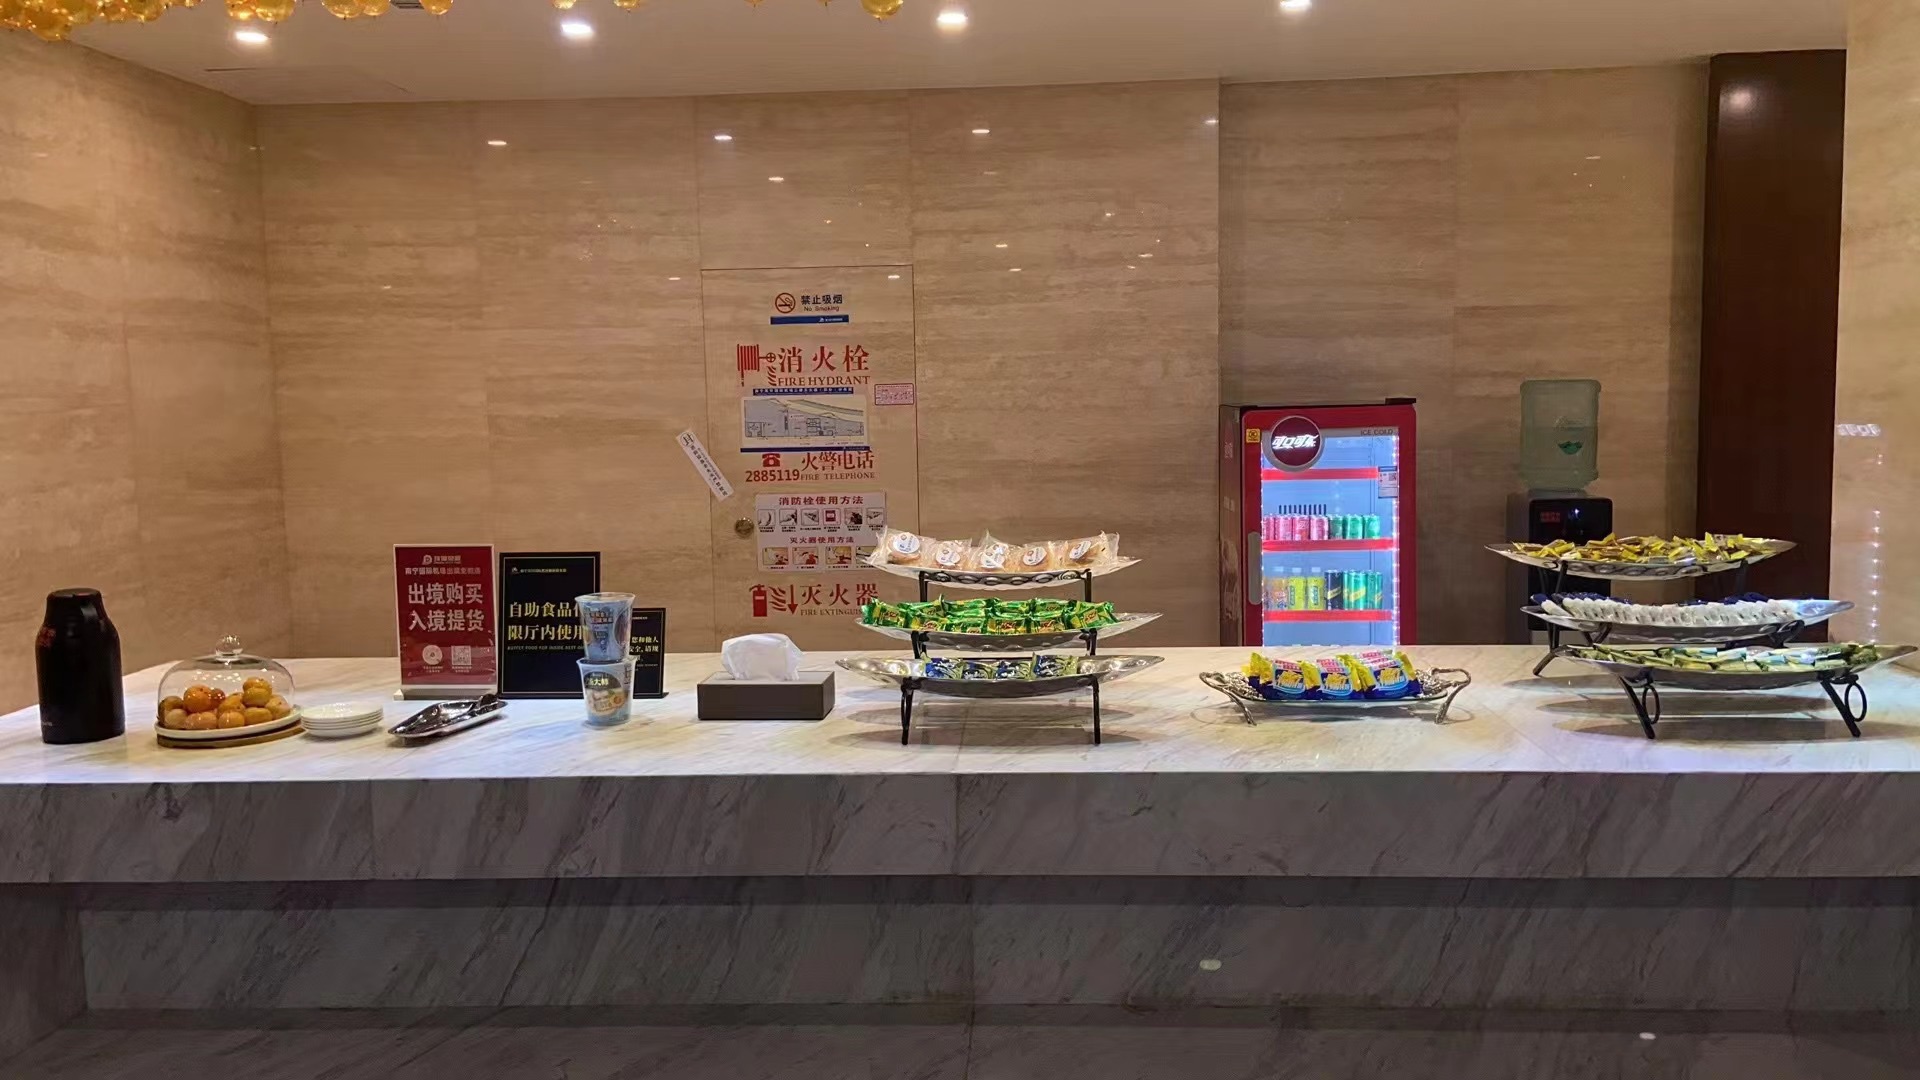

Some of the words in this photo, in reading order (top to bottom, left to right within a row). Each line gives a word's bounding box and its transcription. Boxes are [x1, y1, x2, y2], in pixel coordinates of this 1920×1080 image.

[801, 294, 843, 305] 禁止吸烟
[777, 344, 870, 373] 消火栓
[778, 377, 806, 387] FIRE
[808, 375, 871, 387] HYDRANT
[1271, 433, 1319, 450] 可口可乐
[801, 450, 875, 472] 火警电话
[745, 468, 800, 483] 2885119
[801, 473, 820, 481] FIRE
[824, 472, 875, 480] TELEPHONE
[778, 495, 864, 505] 消防栓使用方法
[789, 536, 854, 544] 灭火器使用方法
[408, 582, 484, 604] 出境购买
[800, 583, 879, 606] 灭火器
[820, 608, 862, 616] EXTINGUIS
[408, 609, 485, 632] 入境提货
